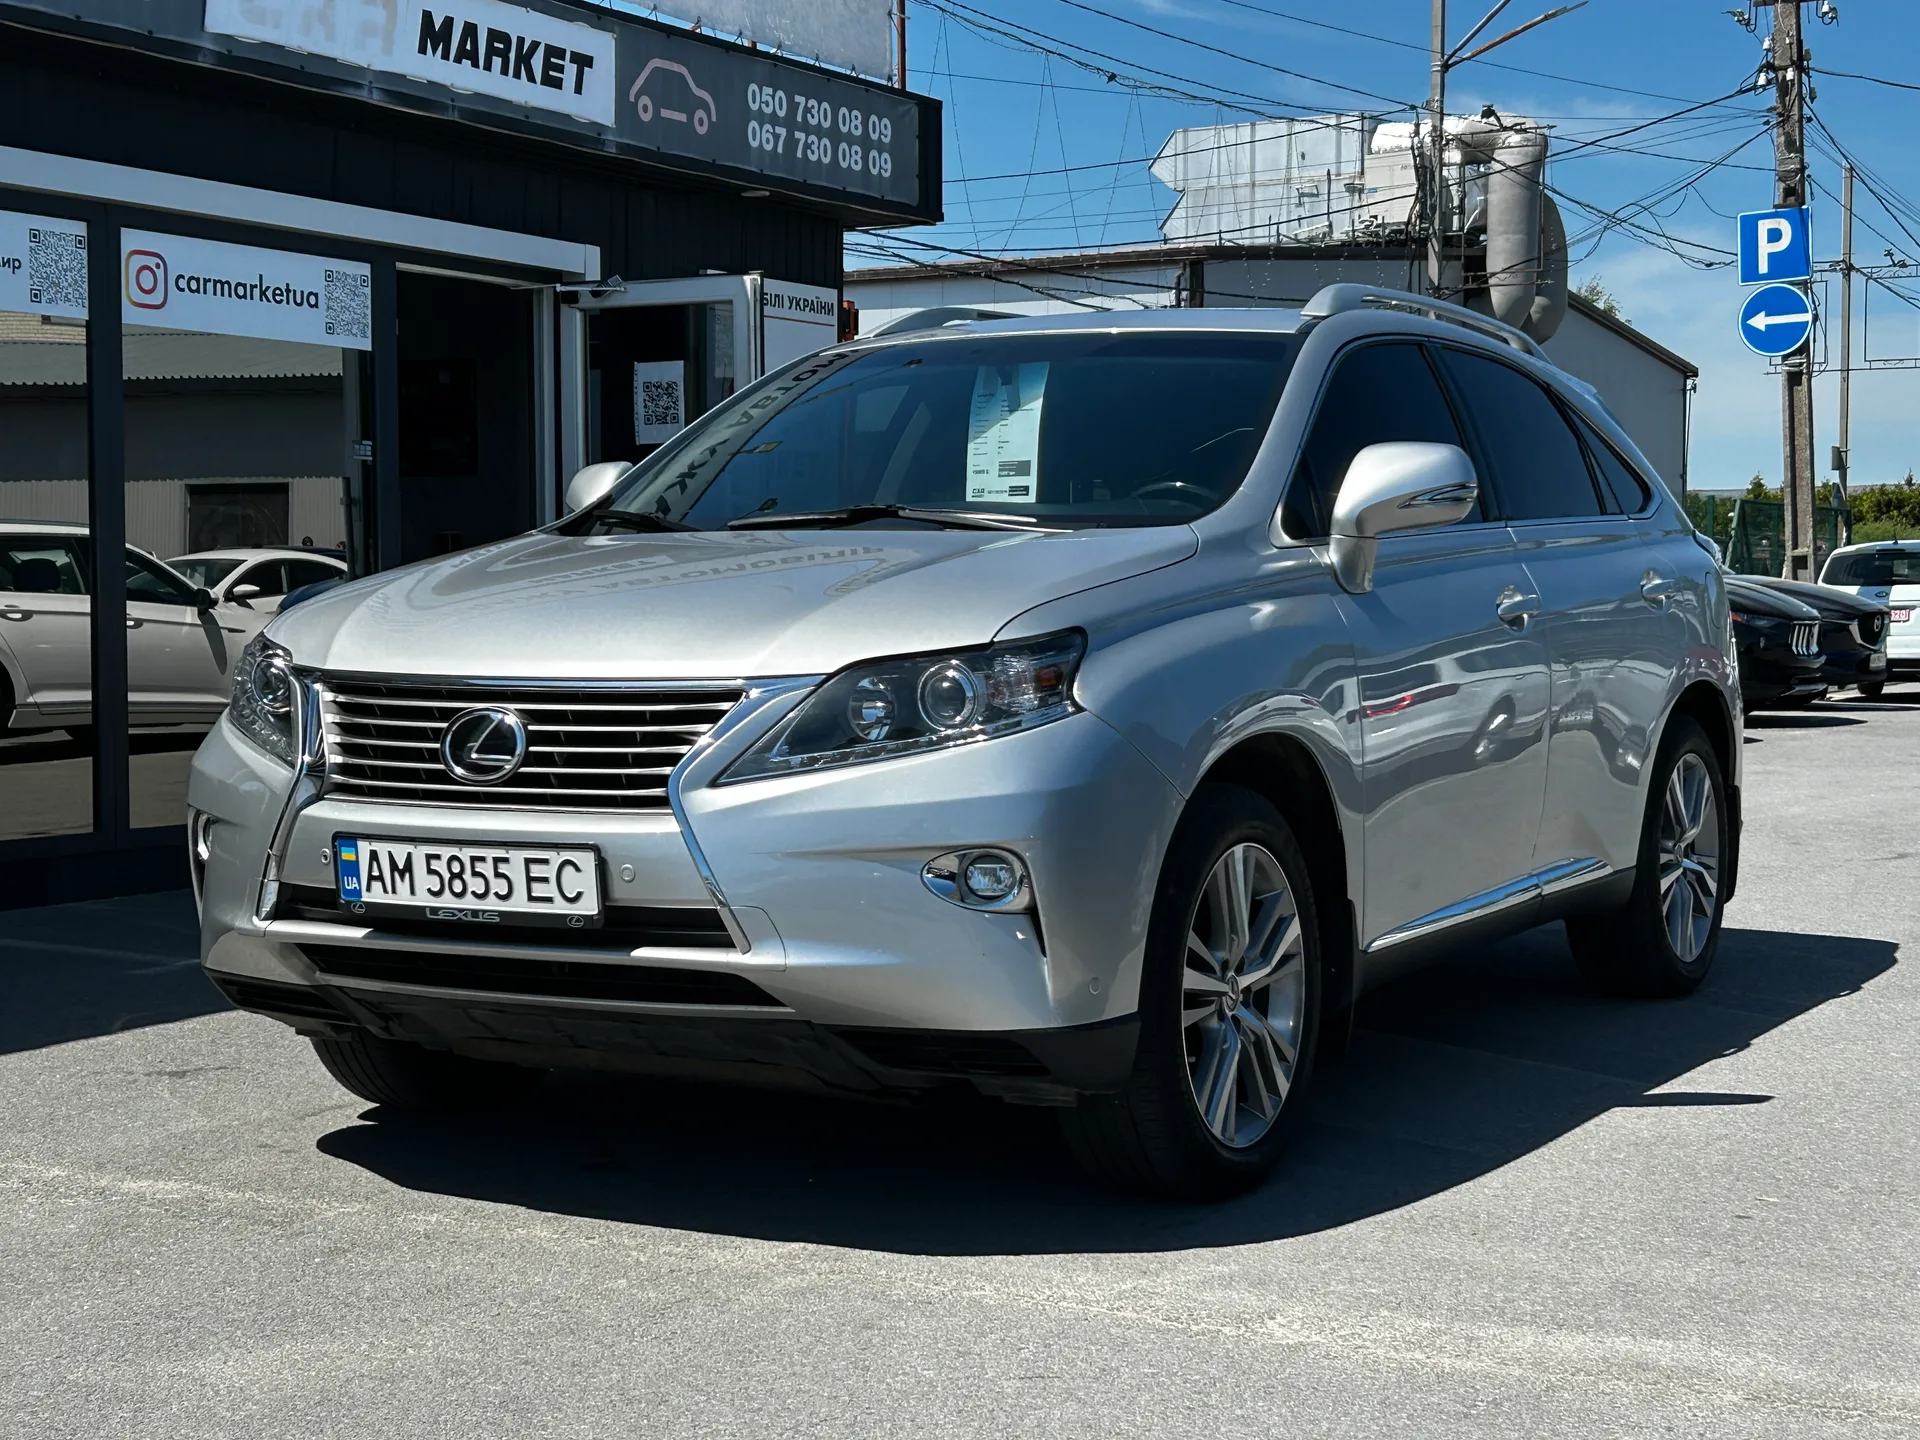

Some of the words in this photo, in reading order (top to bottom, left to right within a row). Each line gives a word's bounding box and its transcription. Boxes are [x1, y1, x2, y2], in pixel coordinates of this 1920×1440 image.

[417, 9, 594, 95] MARKET
[747, 83, 787, 117] 050
[794, 94, 832, 128] 730
[838, 106, 863, 136] 08
[868, 114, 892, 144] 09
[747, 120, 787, 154] 067
[794, 131, 832, 164] 730
[838, 142, 863, 171] 08
[868, 149, 892, 177] 09
[0, 256, 22, 275] ир
[1757, 218, 1792, 275] P
[174, 273, 320, 309] carmarketua
[787, 295, 834, 317] УКРАЇНИ
[344, 876, 360, 890] UA
[365, 849, 417, 897] AM
[424, 852, 513, 901] 5855
[523, 856, 585, 904] EC
[425, 908, 500, 922] LEXUS
